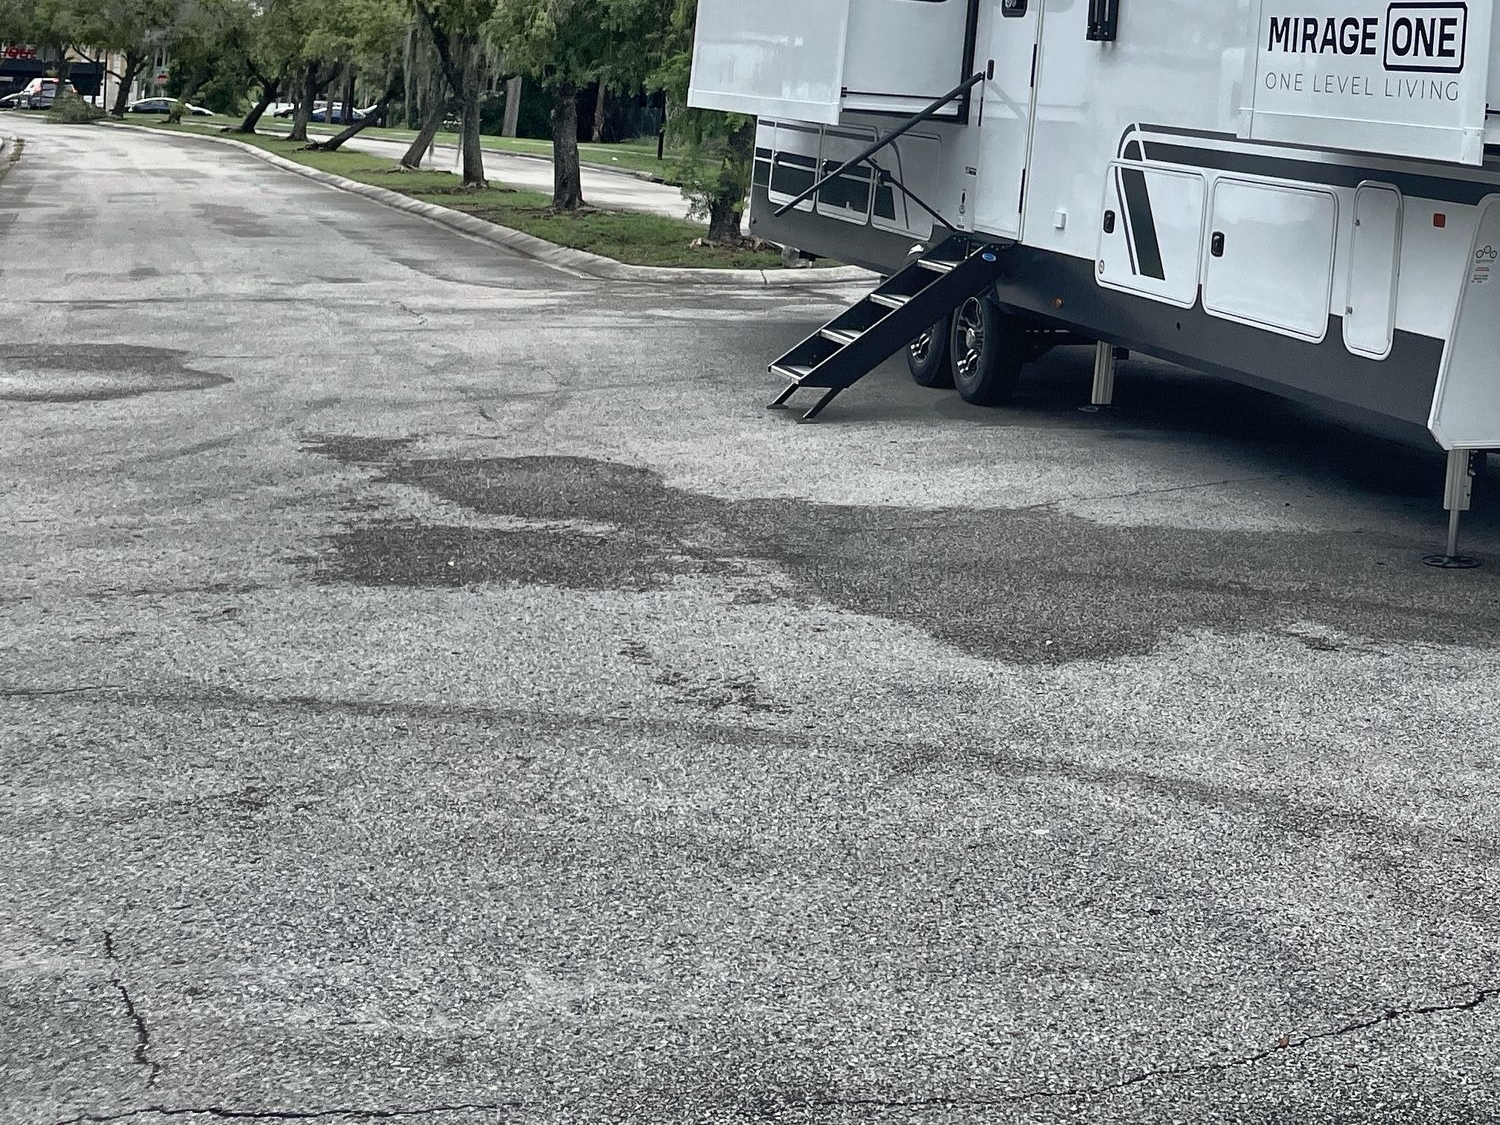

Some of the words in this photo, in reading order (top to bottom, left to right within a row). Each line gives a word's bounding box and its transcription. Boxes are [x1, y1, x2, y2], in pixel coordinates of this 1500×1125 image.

[1267, 16, 1379, 55] MIRAGE
[1391, 16, 1458, 58] ONE
[1265, 72, 1303, 92] ONE
[1312, 74, 1374, 96] LEVEL
[1384, 77, 1459, 102] LIVING
